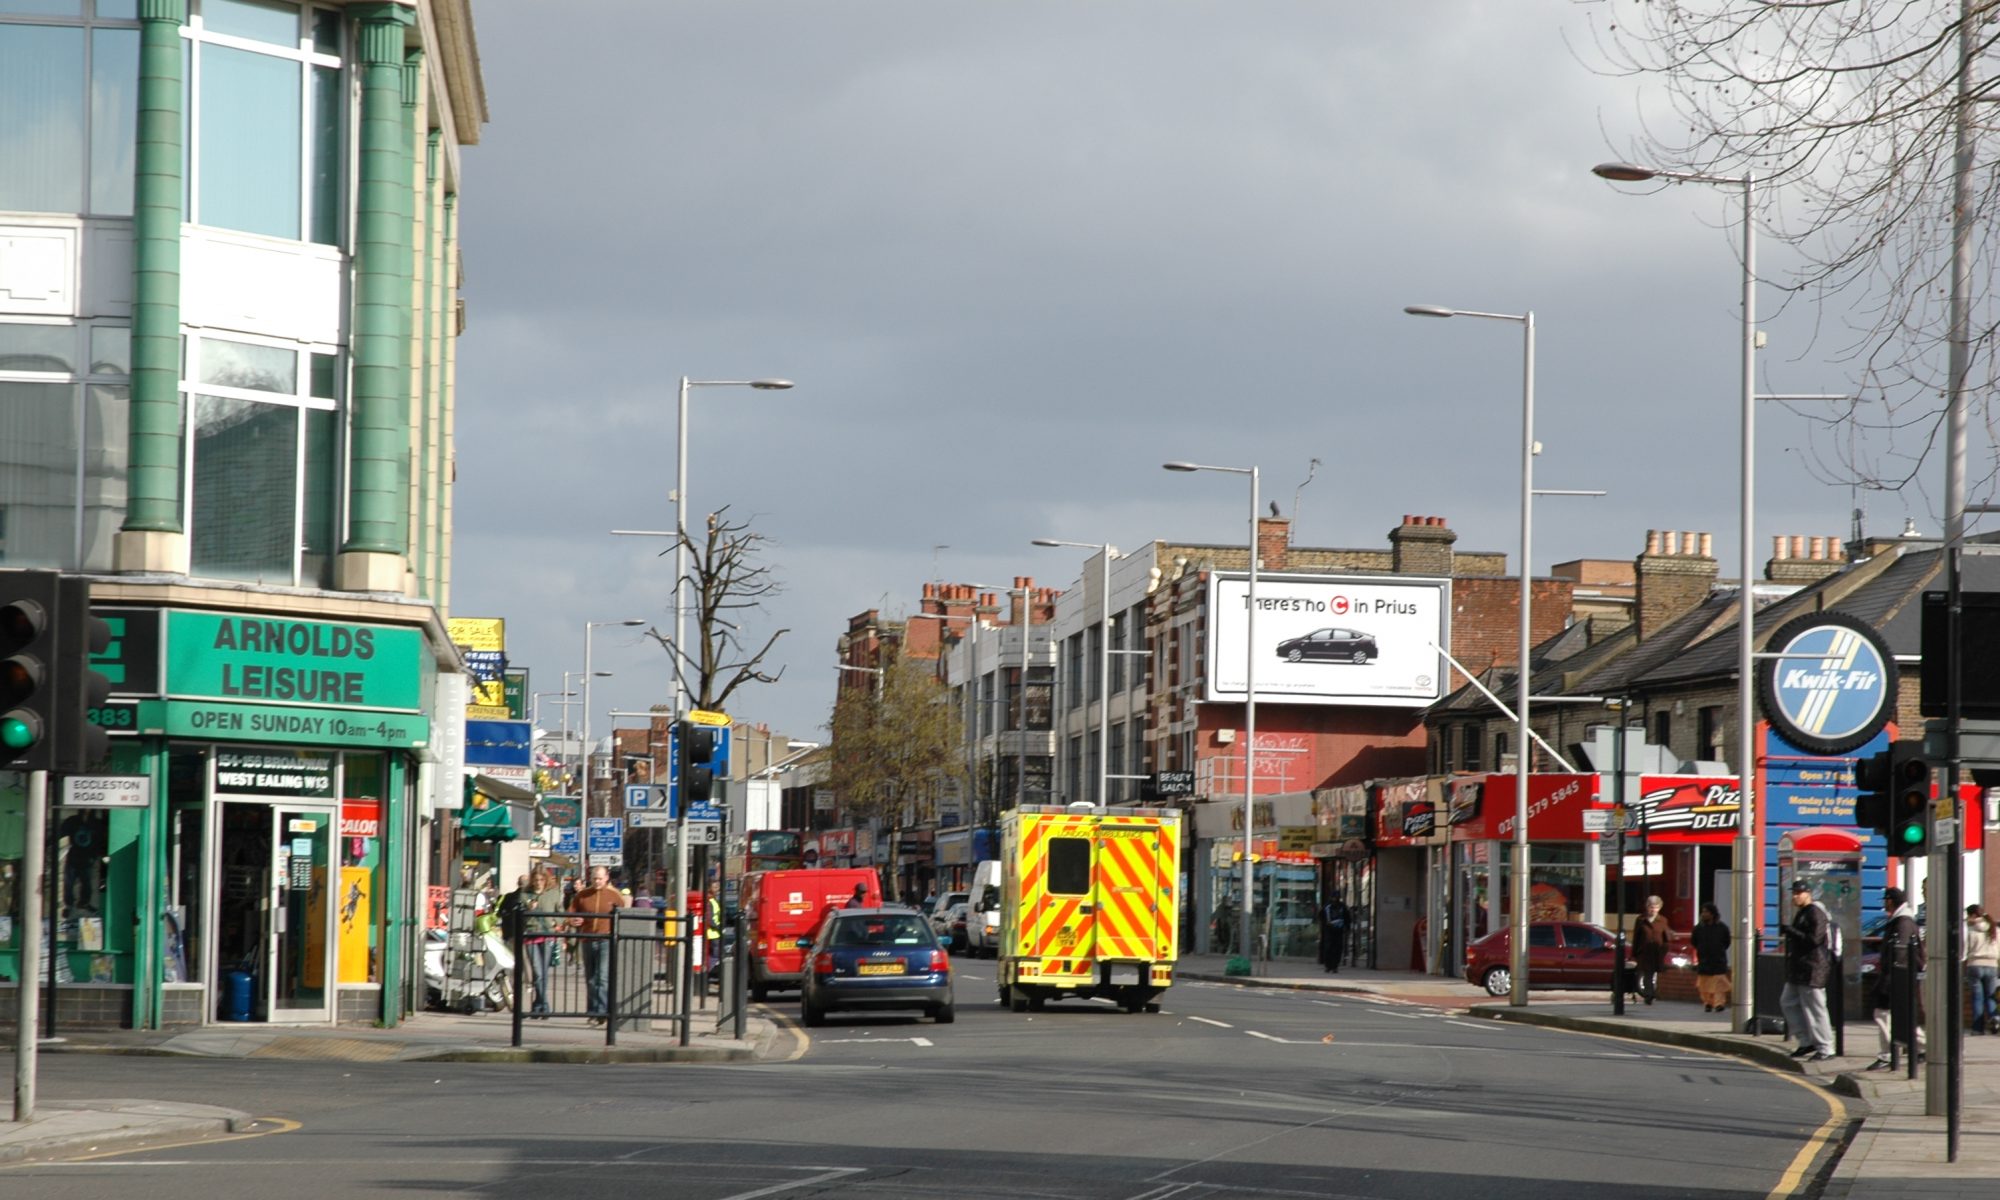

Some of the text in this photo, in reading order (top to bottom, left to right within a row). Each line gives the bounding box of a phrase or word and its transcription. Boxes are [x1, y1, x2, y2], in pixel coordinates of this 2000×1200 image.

[1305, 599, 1326, 612] no
[1354, 598, 1368, 613] in
[1375, 599, 1417, 615] Prius
[213, 618, 375, 660] ARNOLDS
[221, 662, 365, 703] LEISURE
[1782, 669, 1878, 690] Kwik-Fit
[190, 710, 407, 741] OPEN SUNDAY 10am-4pm
[262, 756, 330, 772] BROADWAY
[217, 771, 330, 790] WEST EALING W13
[1160, 772, 1192, 782] BEAUTY
[1800, 770, 1823, 781] Open
[73, 779, 140, 791] ECCLESTON
[1161, 783, 1192, 792] SALON
[73, 791, 106, 802] ROAD
[1527, 797, 1549, 818] 579
[1551, 780, 1580, 805] 5845
[1825, 798, 1835, 806] to
[1057, 830, 1090, 838] LONDON
